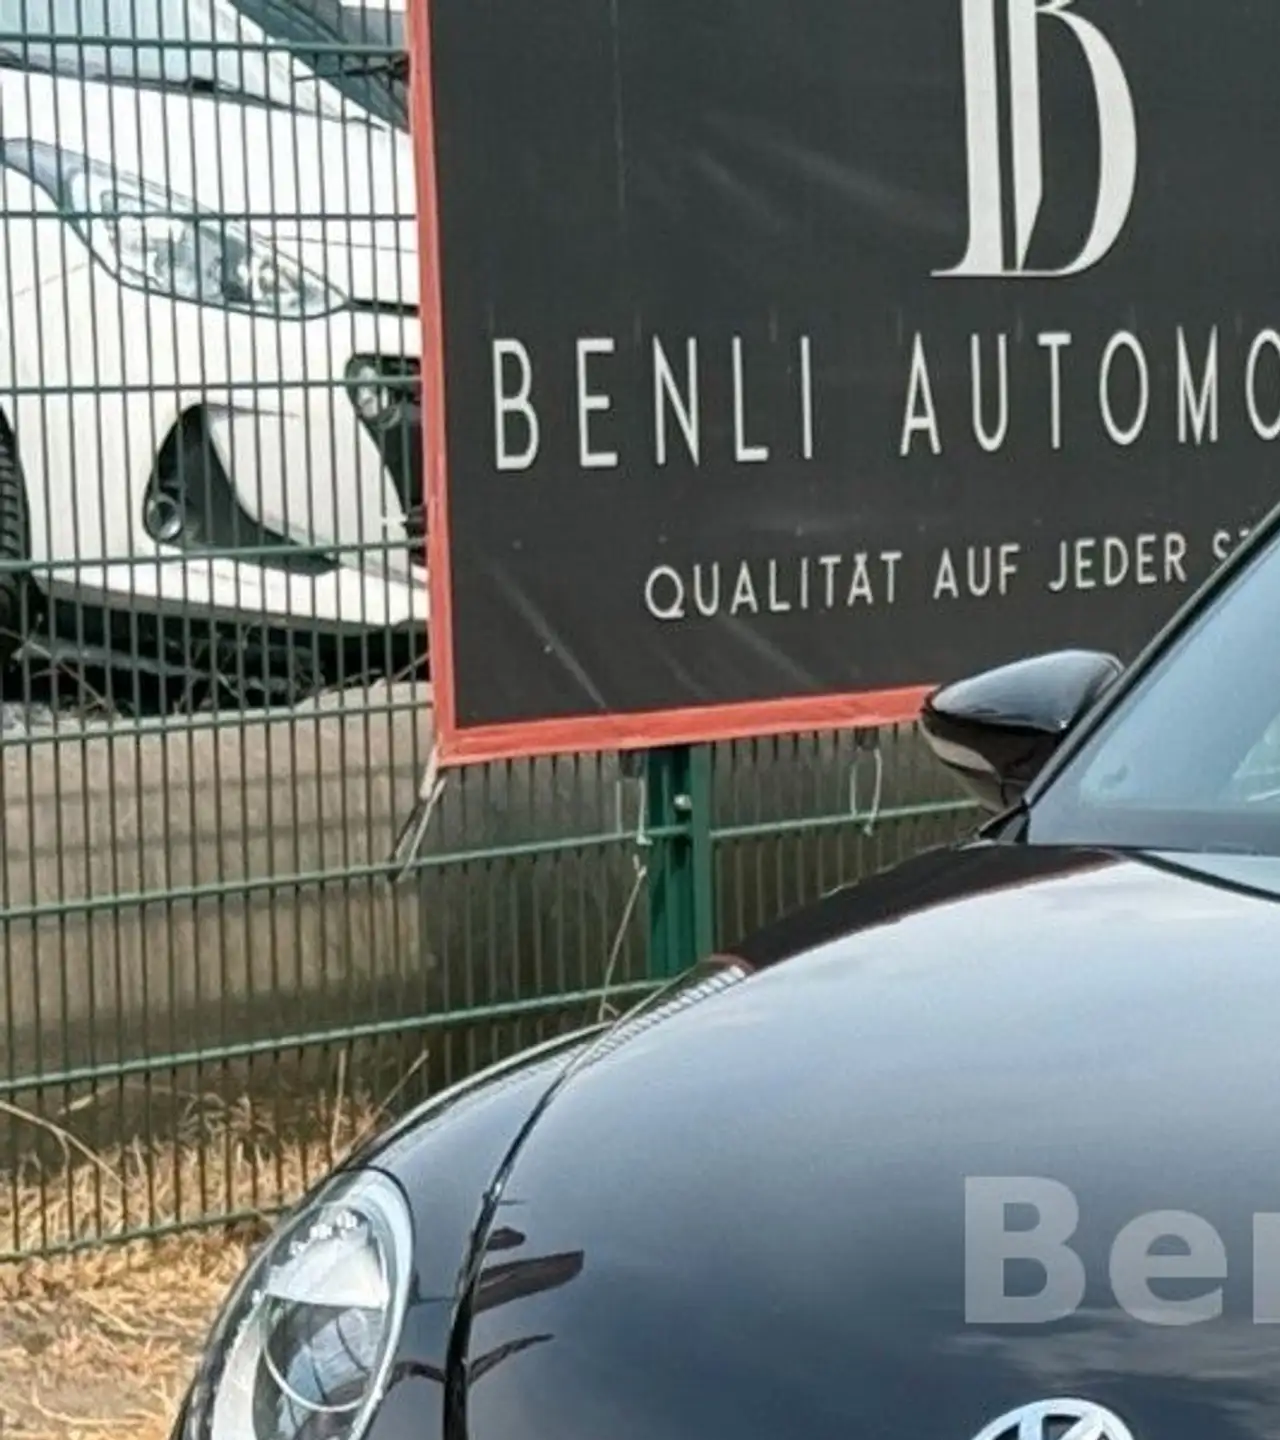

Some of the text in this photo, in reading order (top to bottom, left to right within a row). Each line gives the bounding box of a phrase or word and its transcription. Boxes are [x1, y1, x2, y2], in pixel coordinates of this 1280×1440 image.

[493, 335, 813, 470] BENLI
[645, 551, 902, 619] QUALITÄT
[934, 544, 1020, 600] AUF
[1048, 533, 1188, 592] JEDER
